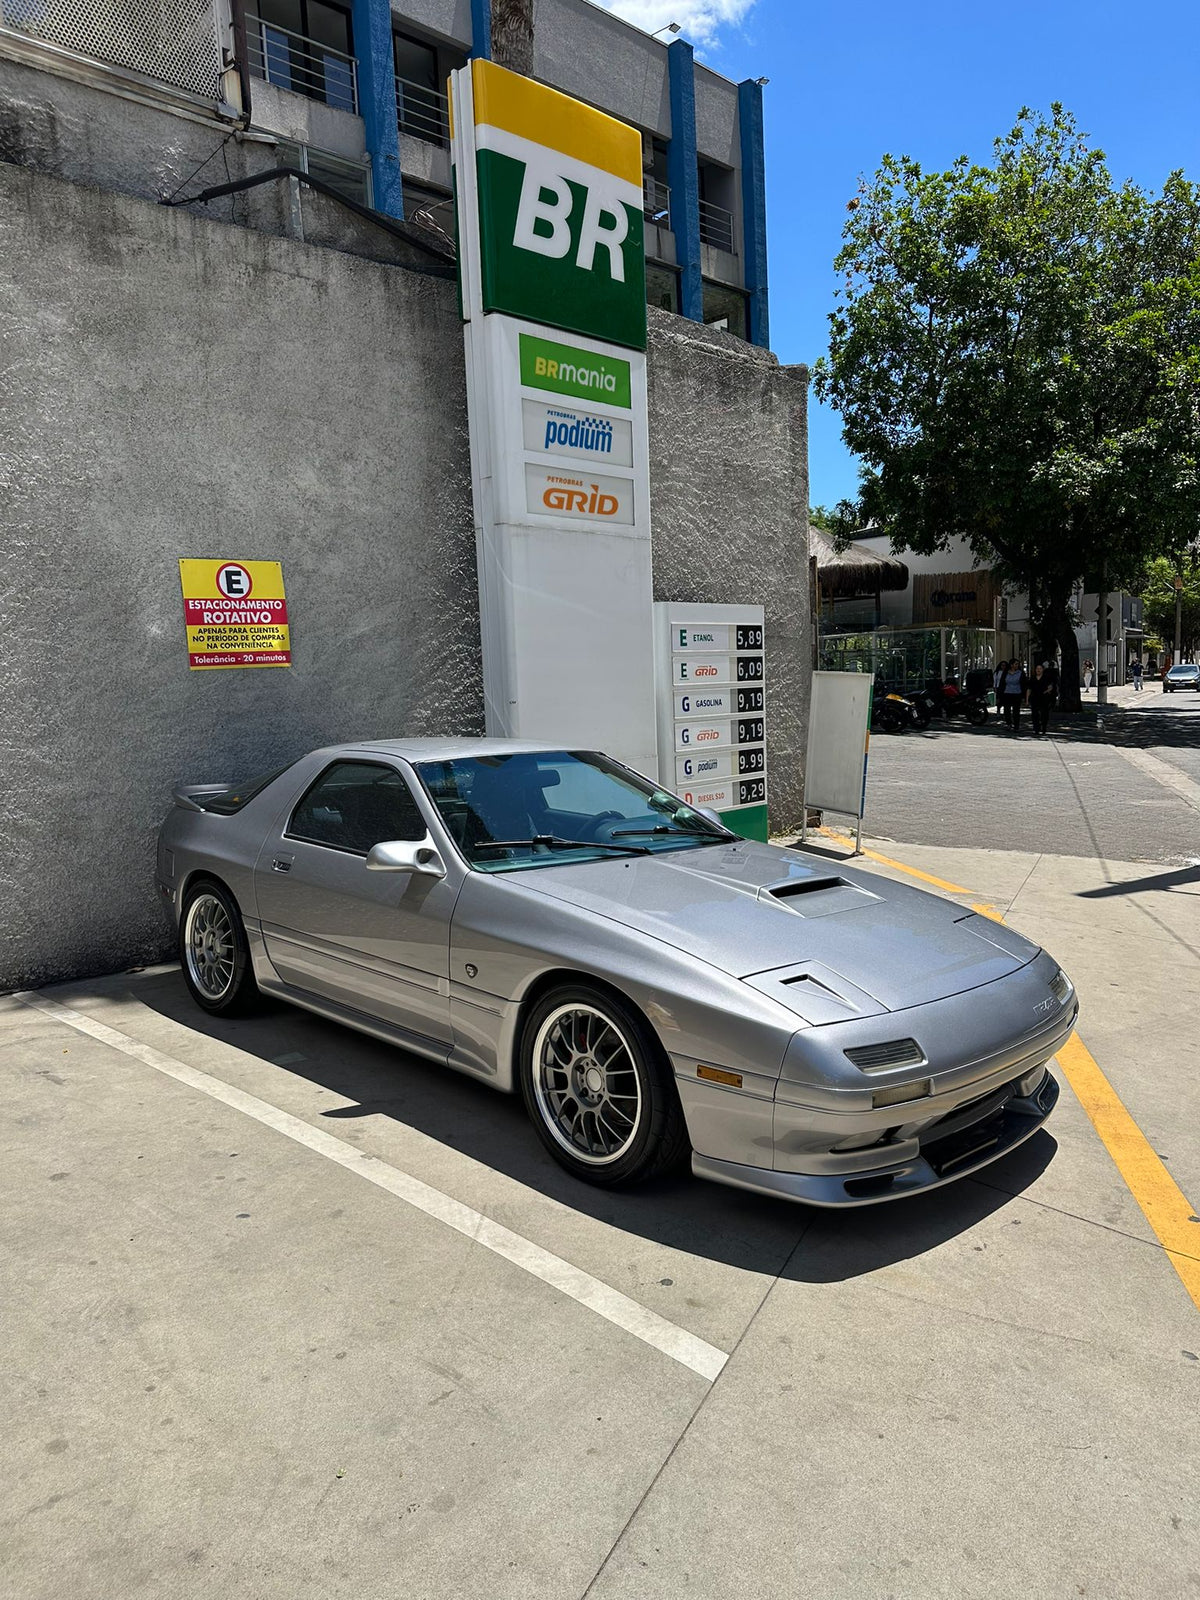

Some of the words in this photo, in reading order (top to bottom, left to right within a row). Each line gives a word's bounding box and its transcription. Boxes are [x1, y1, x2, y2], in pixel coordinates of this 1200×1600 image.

[512, 162, 629, 283] BR
[535, 356, 616, 392] BRmania
[547, 410, 577, 420] PETROBRAS
[544, 419, 613, 453] podium
[547, 475, 583, 487] PETROBRAS
[224, 570, 244, 594] E
[188, 600, 283, 610] ESTACIONAMENTO
[203, 611, 272, 624] ROTATIVO
[249, 626, 280, 634] CLIENTES
[251, 634, 286, 642] COMPRAS
[680, 629, 688, 647] E
[693, 634, 714, 642] ETANOL
[737, 630, 762, 648] 5,89
[194, 655, 236, 664] Tolerância
[243, 654, 254, 662] 20
[256, 653, 287, 662] minutos
[681, 663, 688, 678] E
[738, 661, 762, 679] 6,09
[682, 696, 690, 712] G
[696, 698, 723, 708] GASOLINA
[738, 692, 763, 710] 9,19
[682, 728, 690, 743] G
[739, 722, 763, 741] 9,19
[684, 759, 692, 775] G
[697, 760, 718, 774] podium
[698, 794, 714, 803] DIESEL
[715, 791, 725, 800] S10
[740, 782, 764, 801] 9,29
